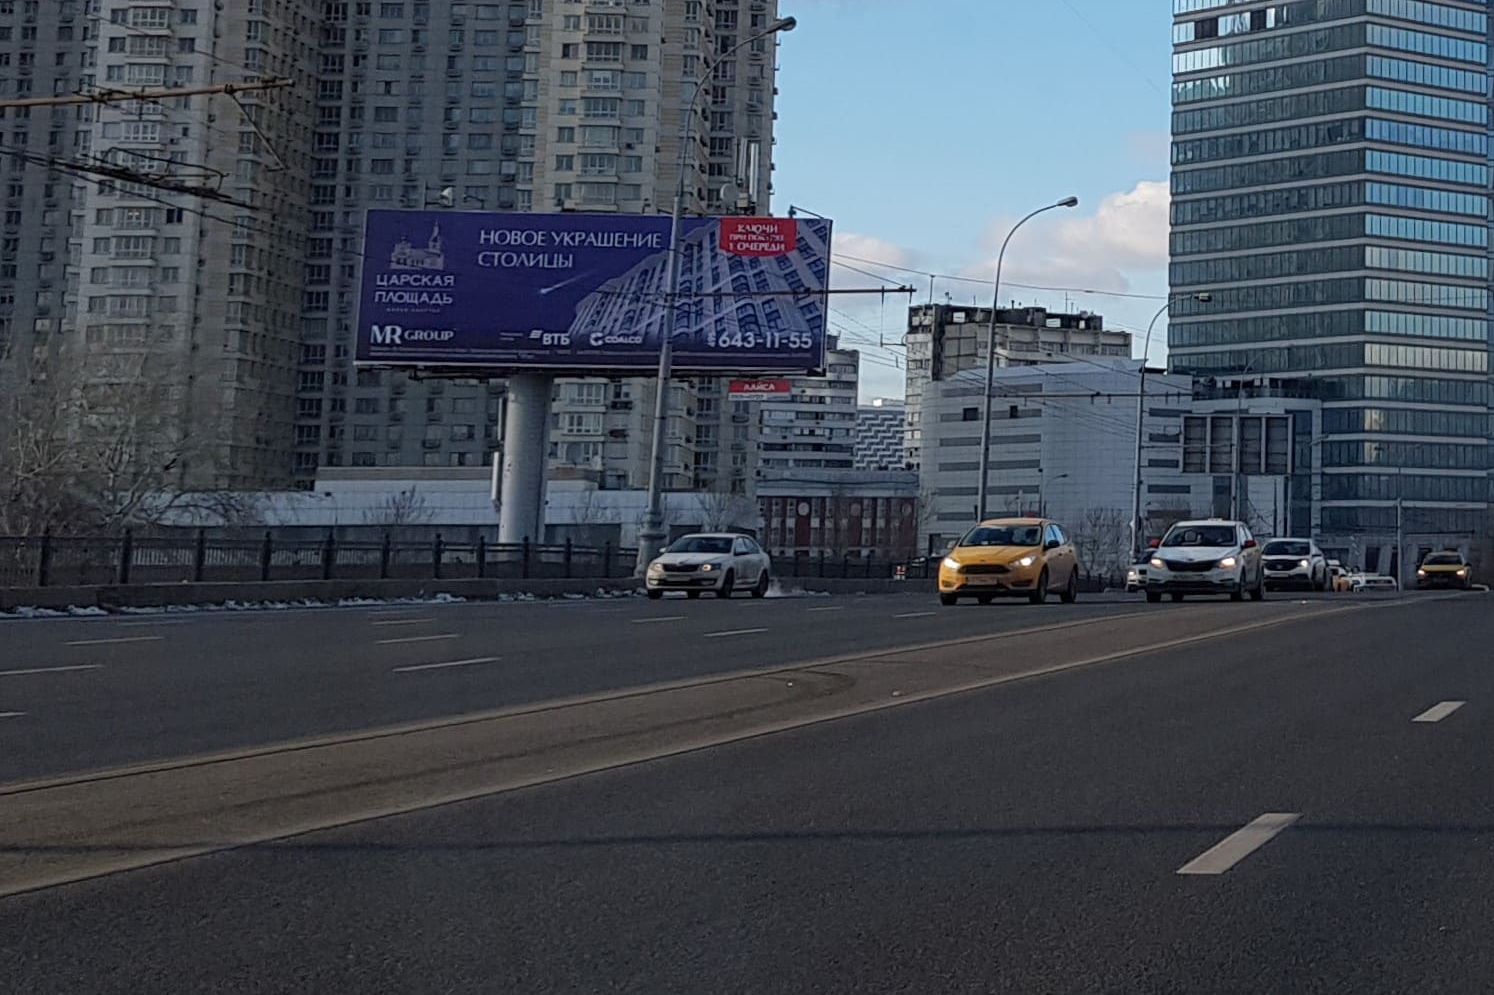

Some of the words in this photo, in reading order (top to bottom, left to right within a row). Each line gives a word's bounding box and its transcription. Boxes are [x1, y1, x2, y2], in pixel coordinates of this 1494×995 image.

[479, 230, 547, 246] НОВОЕ
[551, 231, 662, 248] УКРАШЕНИЕ
[737, 242, 785, 252] ОЧЕРЕДИ
[478, 251, 573, 268] СТОЛИЦЫ
[376, 274, 455, 287] ЦАРСКАЯ
[374, 291, 454, 306] ПЛОЩАДЬ
[370, 325, 402, 344] MR
[404, 330, 454, 341] GROUP
[542, 332, 570, 345] ВТБ
[718, 331, 813, 349] 643-11-55
